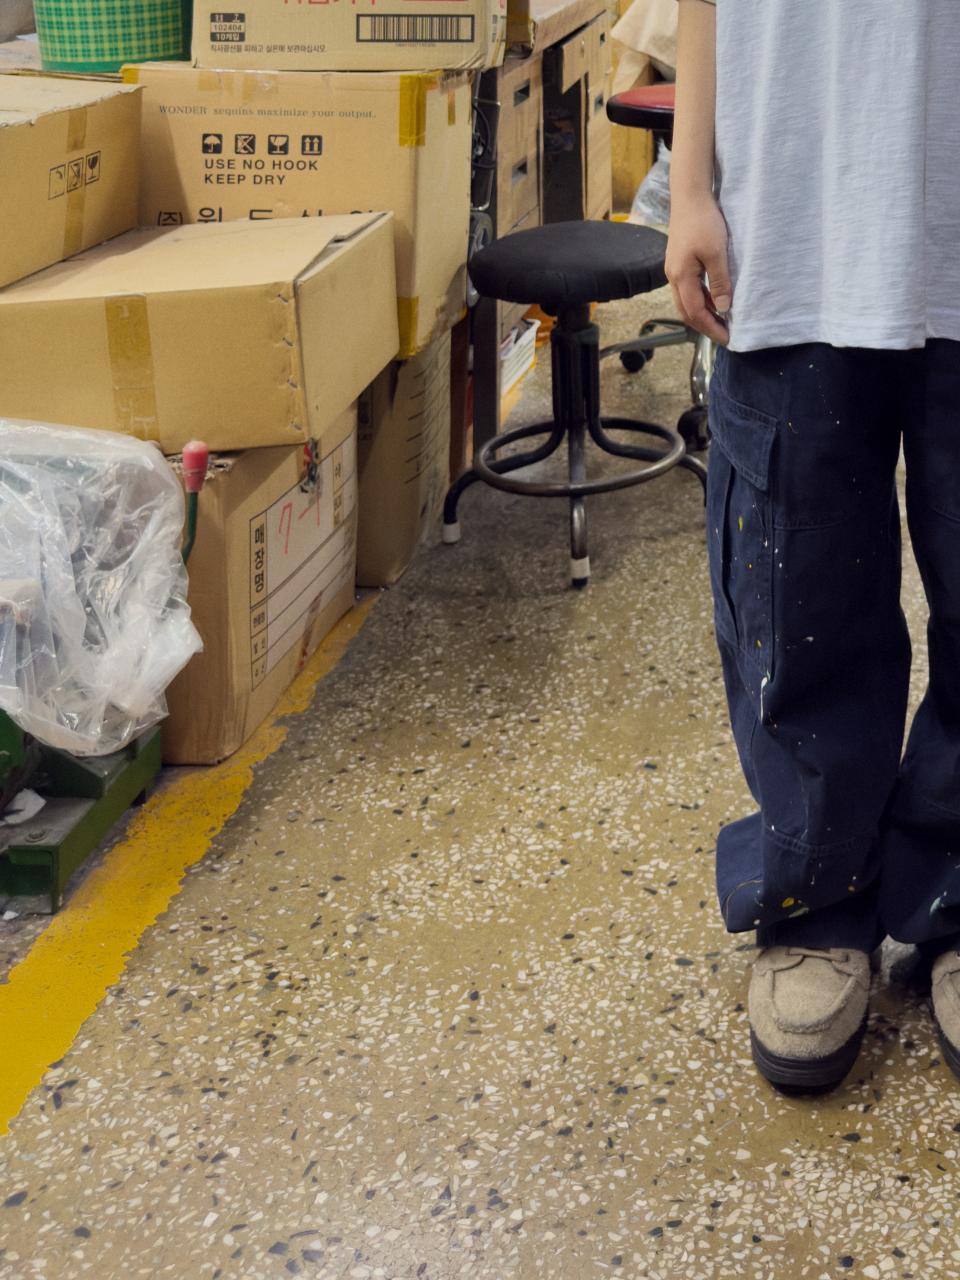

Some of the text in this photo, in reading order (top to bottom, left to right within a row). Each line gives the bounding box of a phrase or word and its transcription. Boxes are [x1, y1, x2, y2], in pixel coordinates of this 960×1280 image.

[159, 105, 377, 119] WONDER sequins maximize your output.
[204, 159, 318, 171] USE NO HOOK
[204, 174, 286, 185] KEEP DRY
